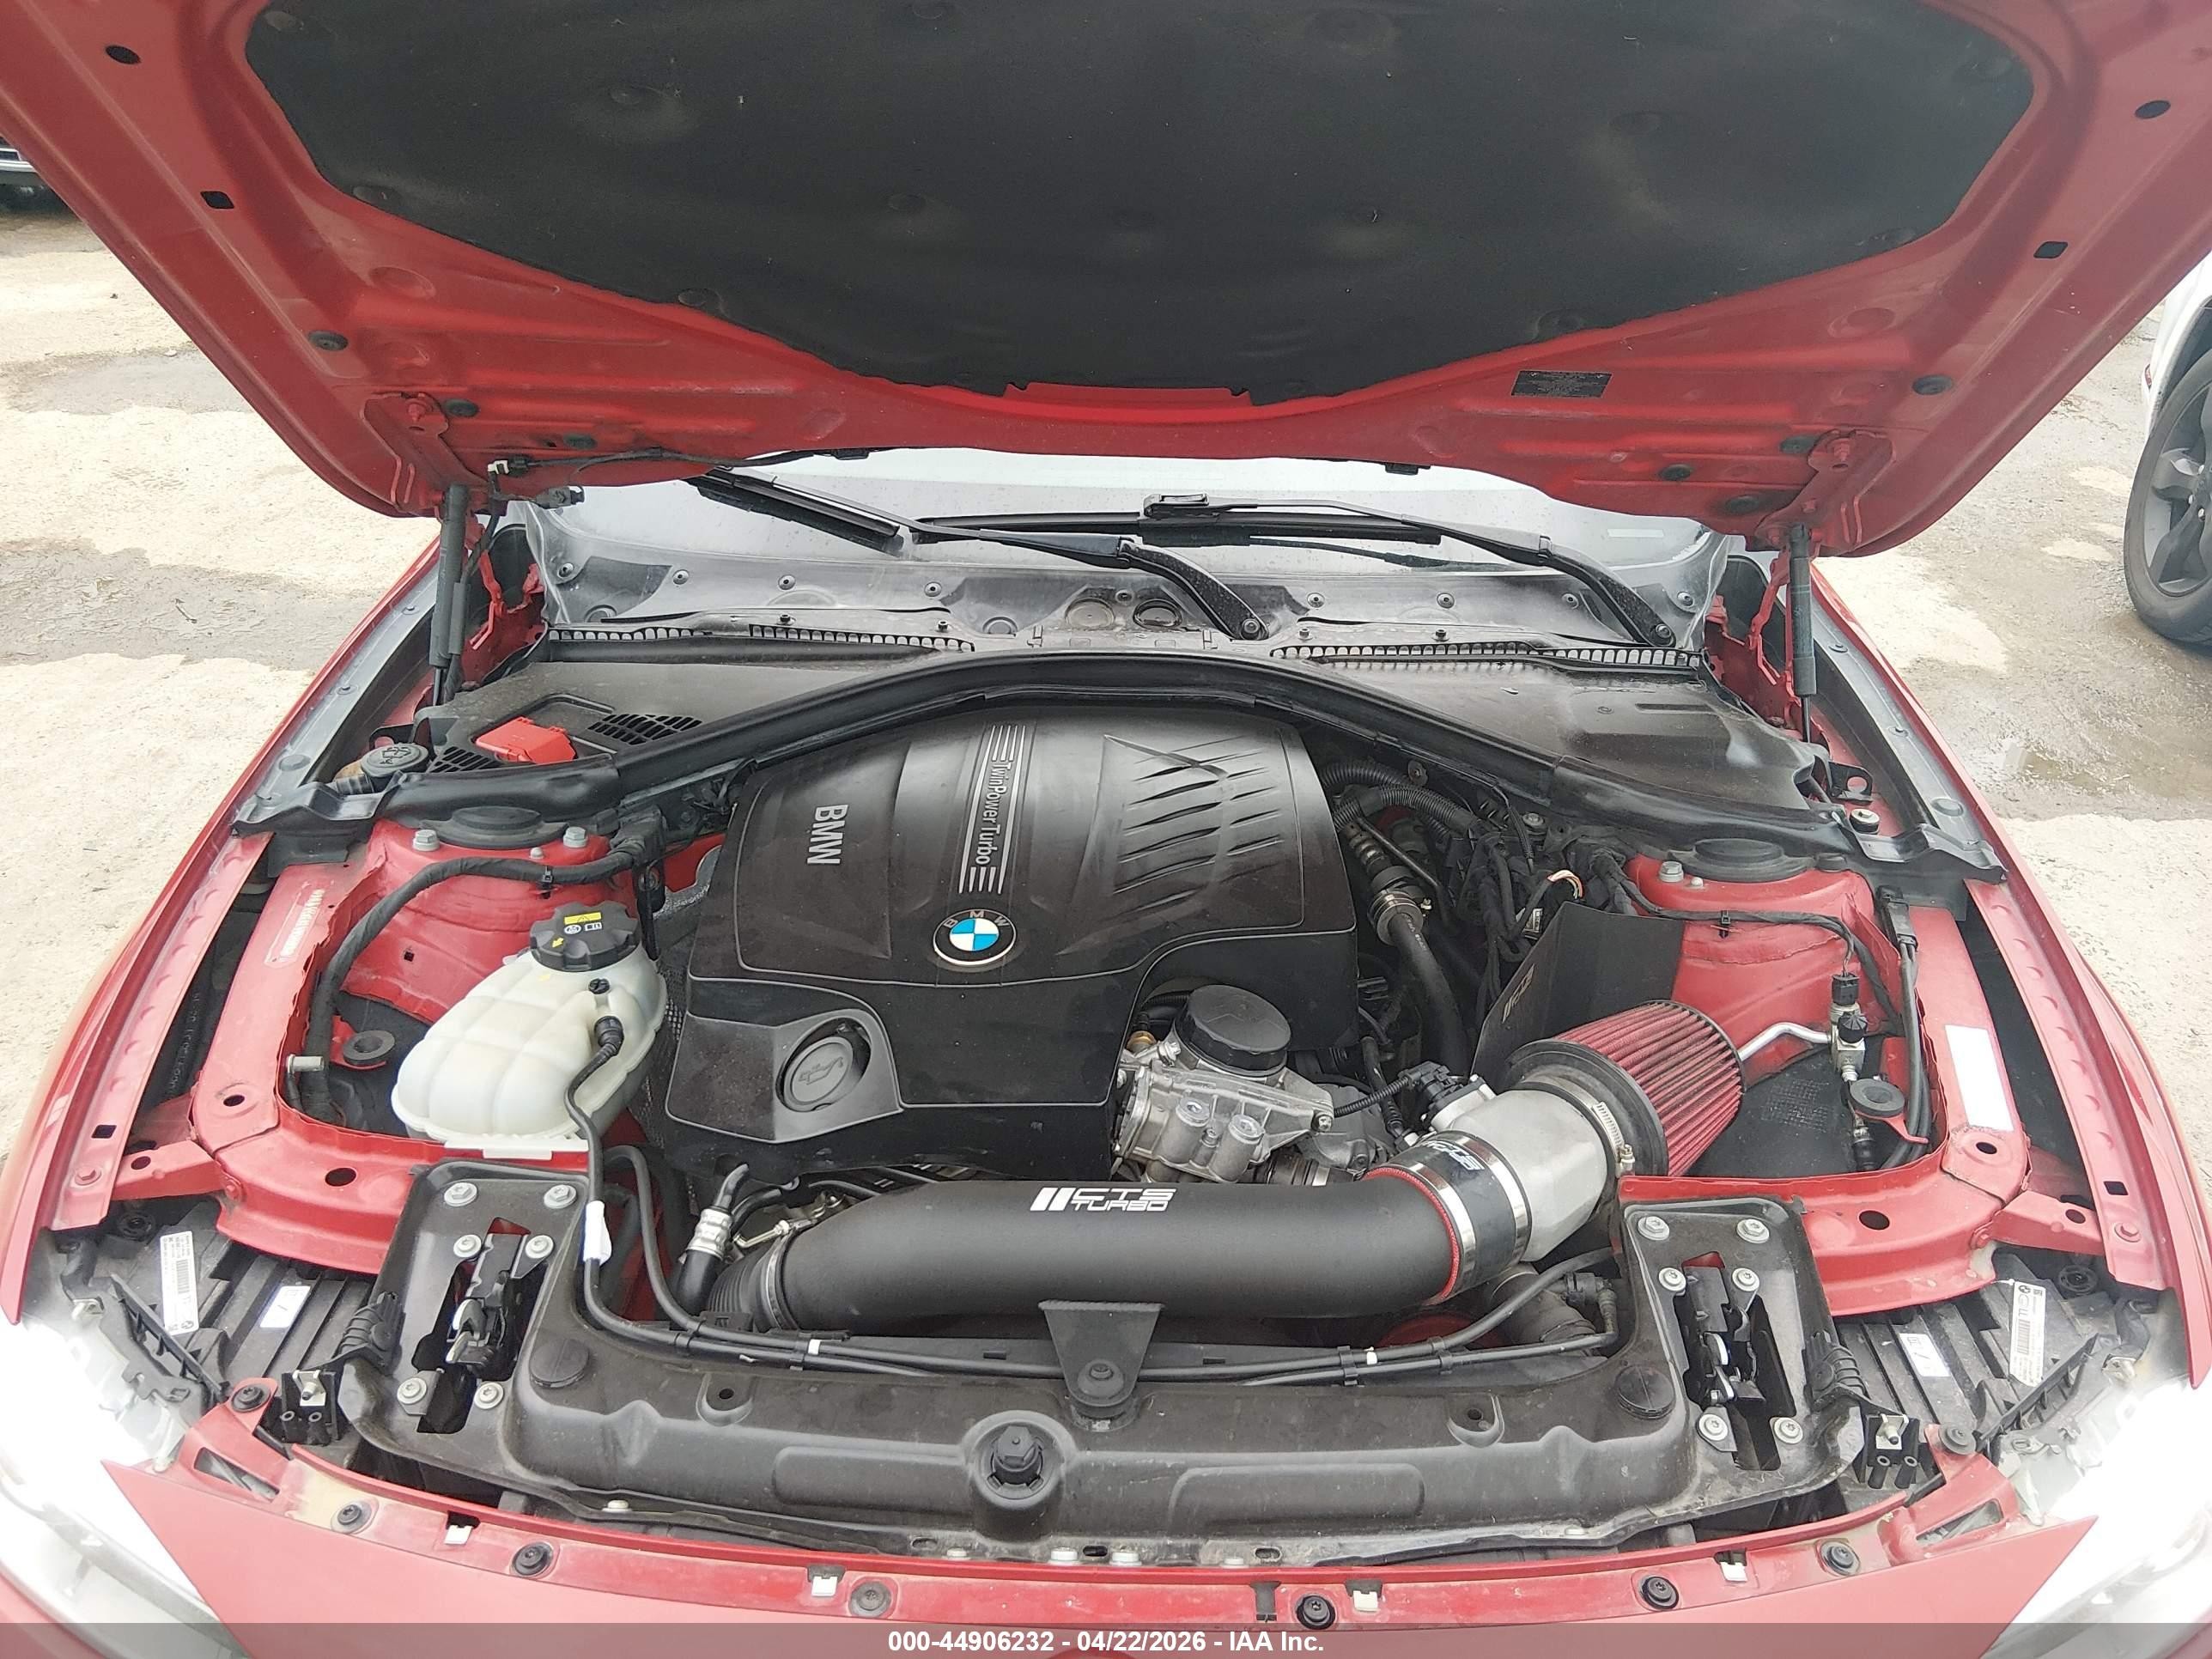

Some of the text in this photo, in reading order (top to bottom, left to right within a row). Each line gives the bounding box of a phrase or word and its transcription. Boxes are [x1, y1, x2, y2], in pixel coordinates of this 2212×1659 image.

[975, 763, 1012, 866] TwinPower Turbo
[806, 804, 849, 865] BMW
[943, 910, 1011, 929] BMW
[1071, 1188, 1177, 1201] CTS
[1069, 1200, 1170, 1212] TURBO
